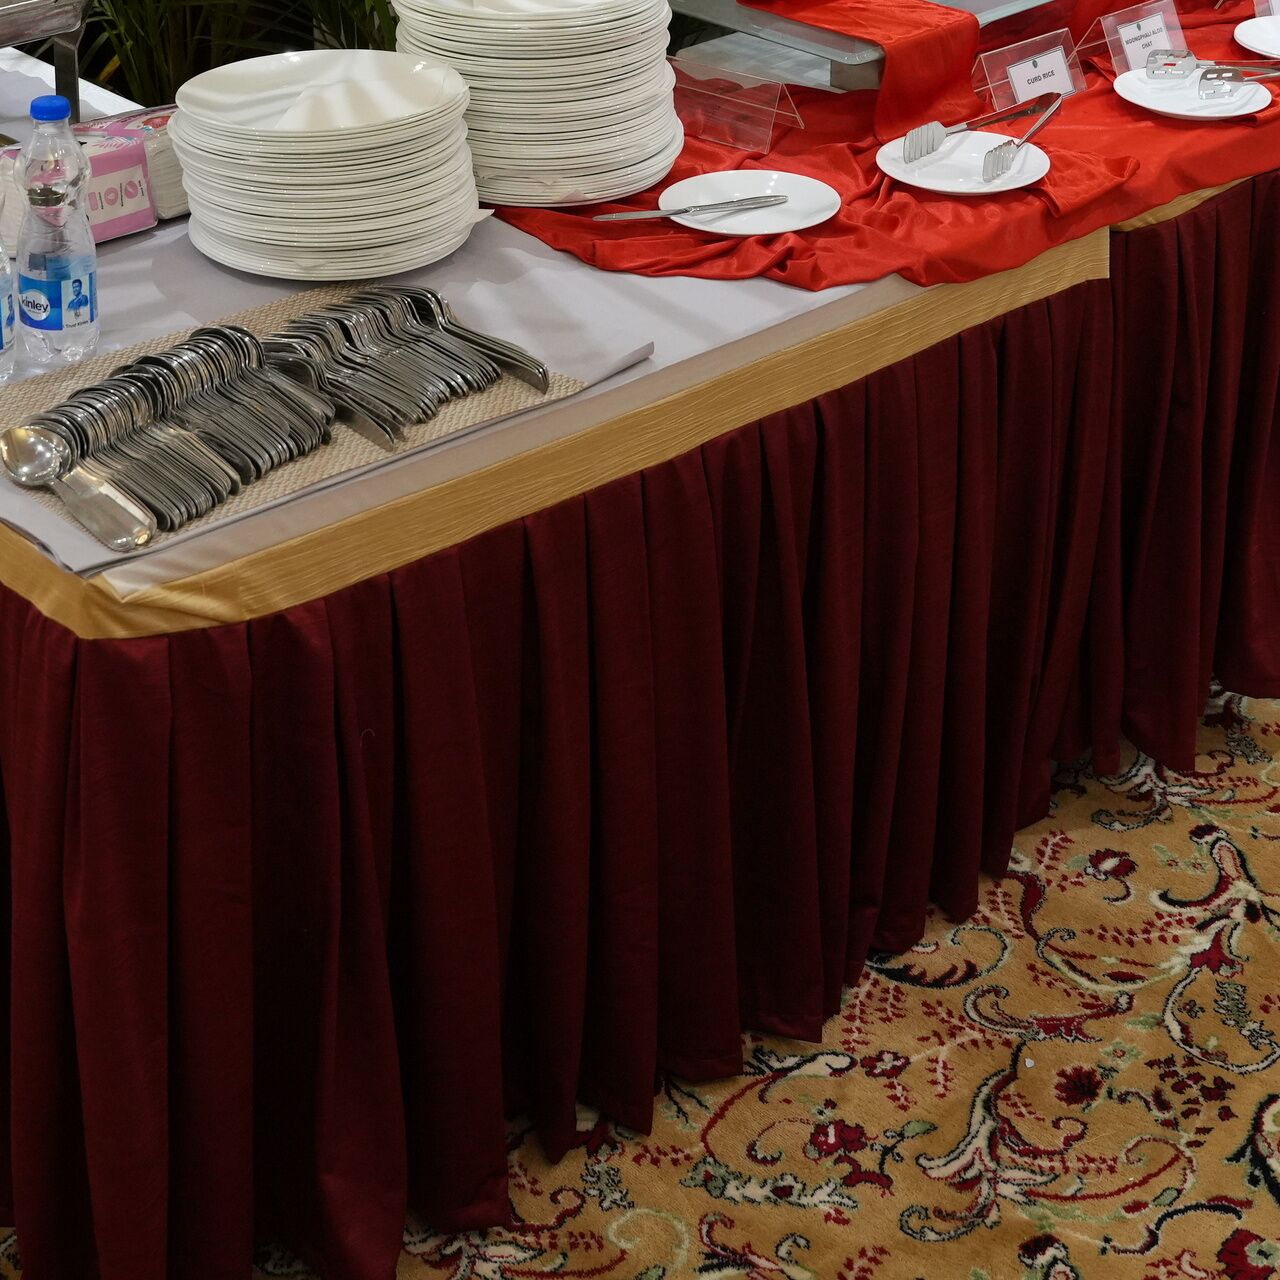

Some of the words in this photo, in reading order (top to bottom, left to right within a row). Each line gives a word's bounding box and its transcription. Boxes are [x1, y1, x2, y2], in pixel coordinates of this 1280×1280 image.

[1027, 75, 1042, 85] CURD
[1042, 69, 1055, 80] RICE
[21, 295, 49, 313] kinley
